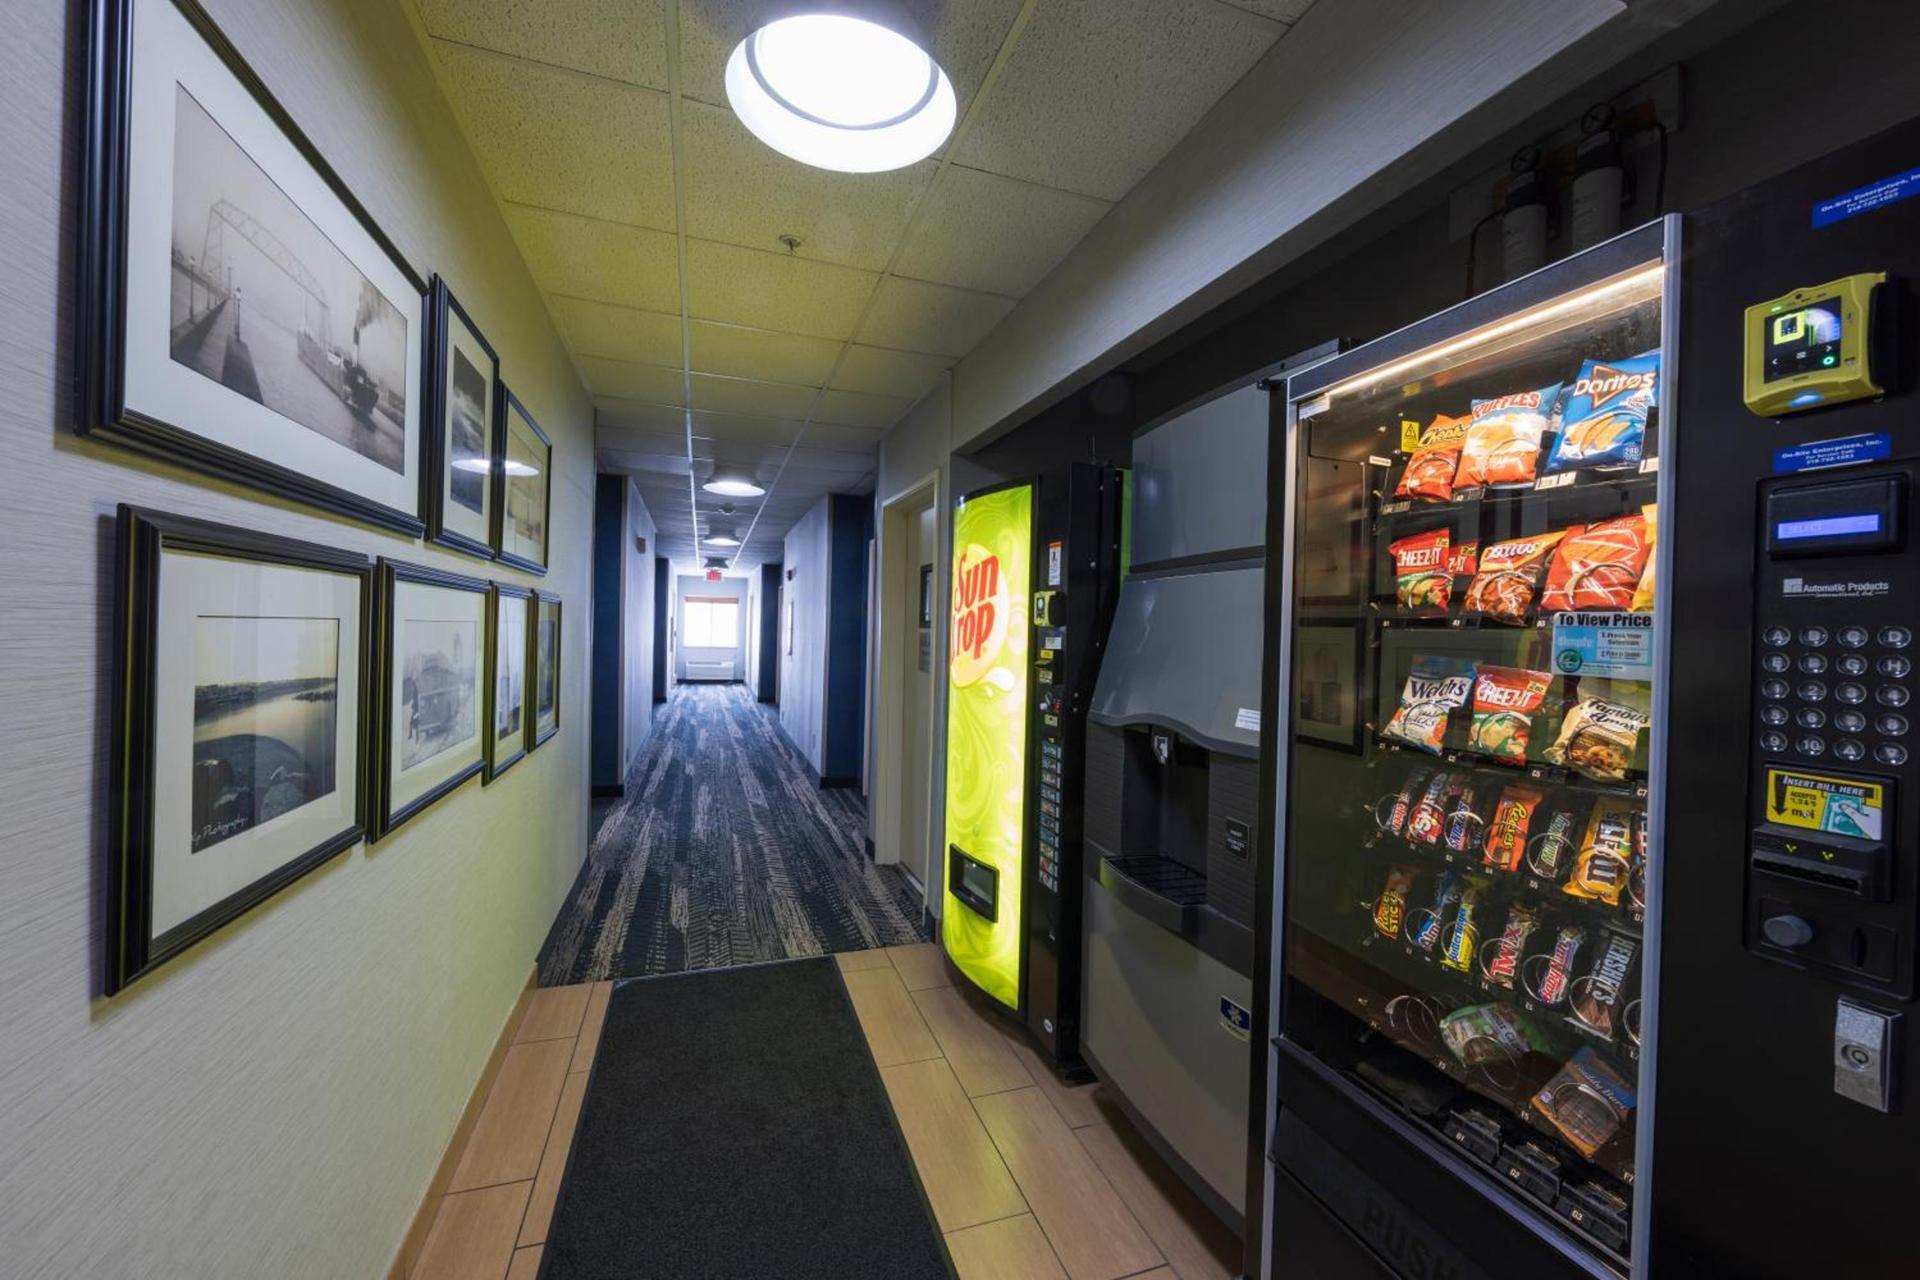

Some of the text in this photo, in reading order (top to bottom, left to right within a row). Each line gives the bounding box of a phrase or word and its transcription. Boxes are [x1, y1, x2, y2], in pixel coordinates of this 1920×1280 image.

[1573, 372, 1657, 396] Doritos
[955, 553, 999, 613] Sun
[1803, 581, 1889, 593] Automatic Products
[1560, 613, 1652, 627] To View Price
[1772, 630, 1784, 641] A
[1888, 631, 1902, 642] D
[1846, 659, 1860, 671] G
[1887, 660, 1901, 671] H
[1411, 680, 1466, 700] Welch's
[1476, 680, 1532, 708] CHEEZ-IT
[1773, 685, 1781, 693] 1
[1808, 685, 1819, 695] 2
[1588, 698, 1650, 724] Famous
[1589, 712, 1639, 733] Amos
[1807, 713, 1817, 723] 6
[1769, 736, 1780, 746] 9
[1803, 740, 1819, 750] 10
[1782, 776, 1866, 797] INSERT BILL HERE
[1592, 935, 1636, 1006] HERSHEY'S
